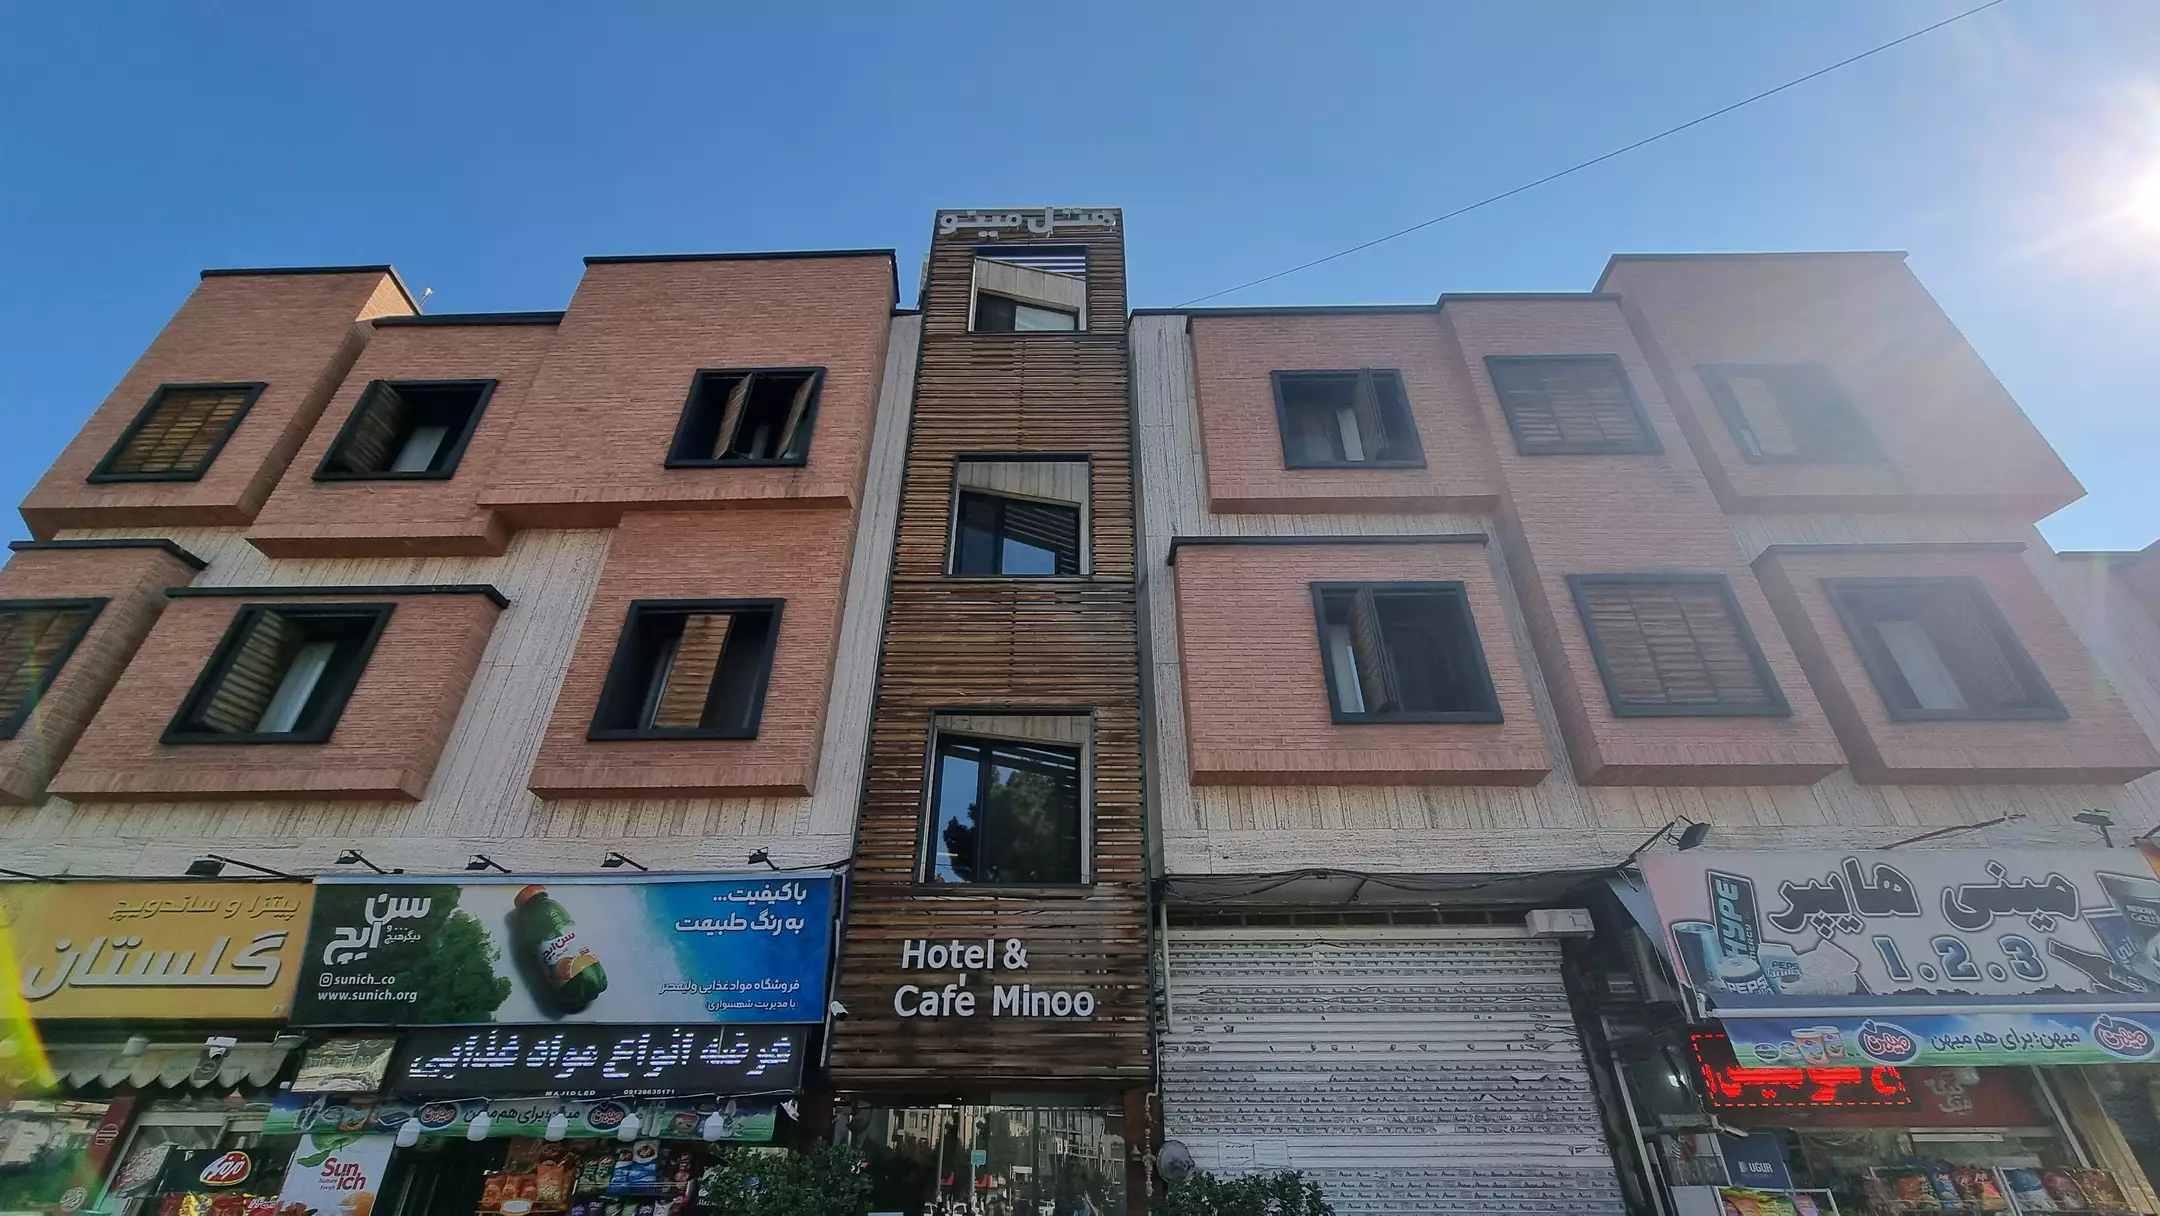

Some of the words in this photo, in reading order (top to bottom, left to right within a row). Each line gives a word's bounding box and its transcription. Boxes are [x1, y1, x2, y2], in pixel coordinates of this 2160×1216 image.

[939, 208, 1023, 239] مینو
[1027, 206, 1117, 237] هتل
[108, 895, 221, 921] ساندویچ
[224, 898, 243, 919] و
[248, 895, 302, 921] پیتزا
[365, 893, 432, 925] سن
[1768, 858, 1921, 939] هایپر
[1942, 861, 2079, 932] مینی
[675, 912, 748, 936] طبیعت
[750, 908, 783, 936] رنگ
[785, 917, 805, 935] به
[323, 921, 381, 966] ایچ
[901, 938, 995, 970] Hotel
[1002, 937, 1029, 970] &
[22, 929, 290, 1001] گلستان
[333, 973, 396, 985] sunich_co
[318, 989, 418, 1003] www.sunich.org
[754, 977, 800, 994] فروشگاه
[754, 1000, 788, 1011] مدیریت
[992, 983, 1096, 1017] Minoo
[1863, 1027, 1912, 1057] میهن
[1930, 1032, 1973, 1052] میهن
[1973, 1031, 1999, 1051] هم
[1999, 1027, 2034, 1051] برای
[2100, 1022, 2147, 1053] میهن
[526, 1034, 599, 1080] مواد
[602, 1027, 695, 1078] انواع
[320, 1157, 360, 1177] Sun
